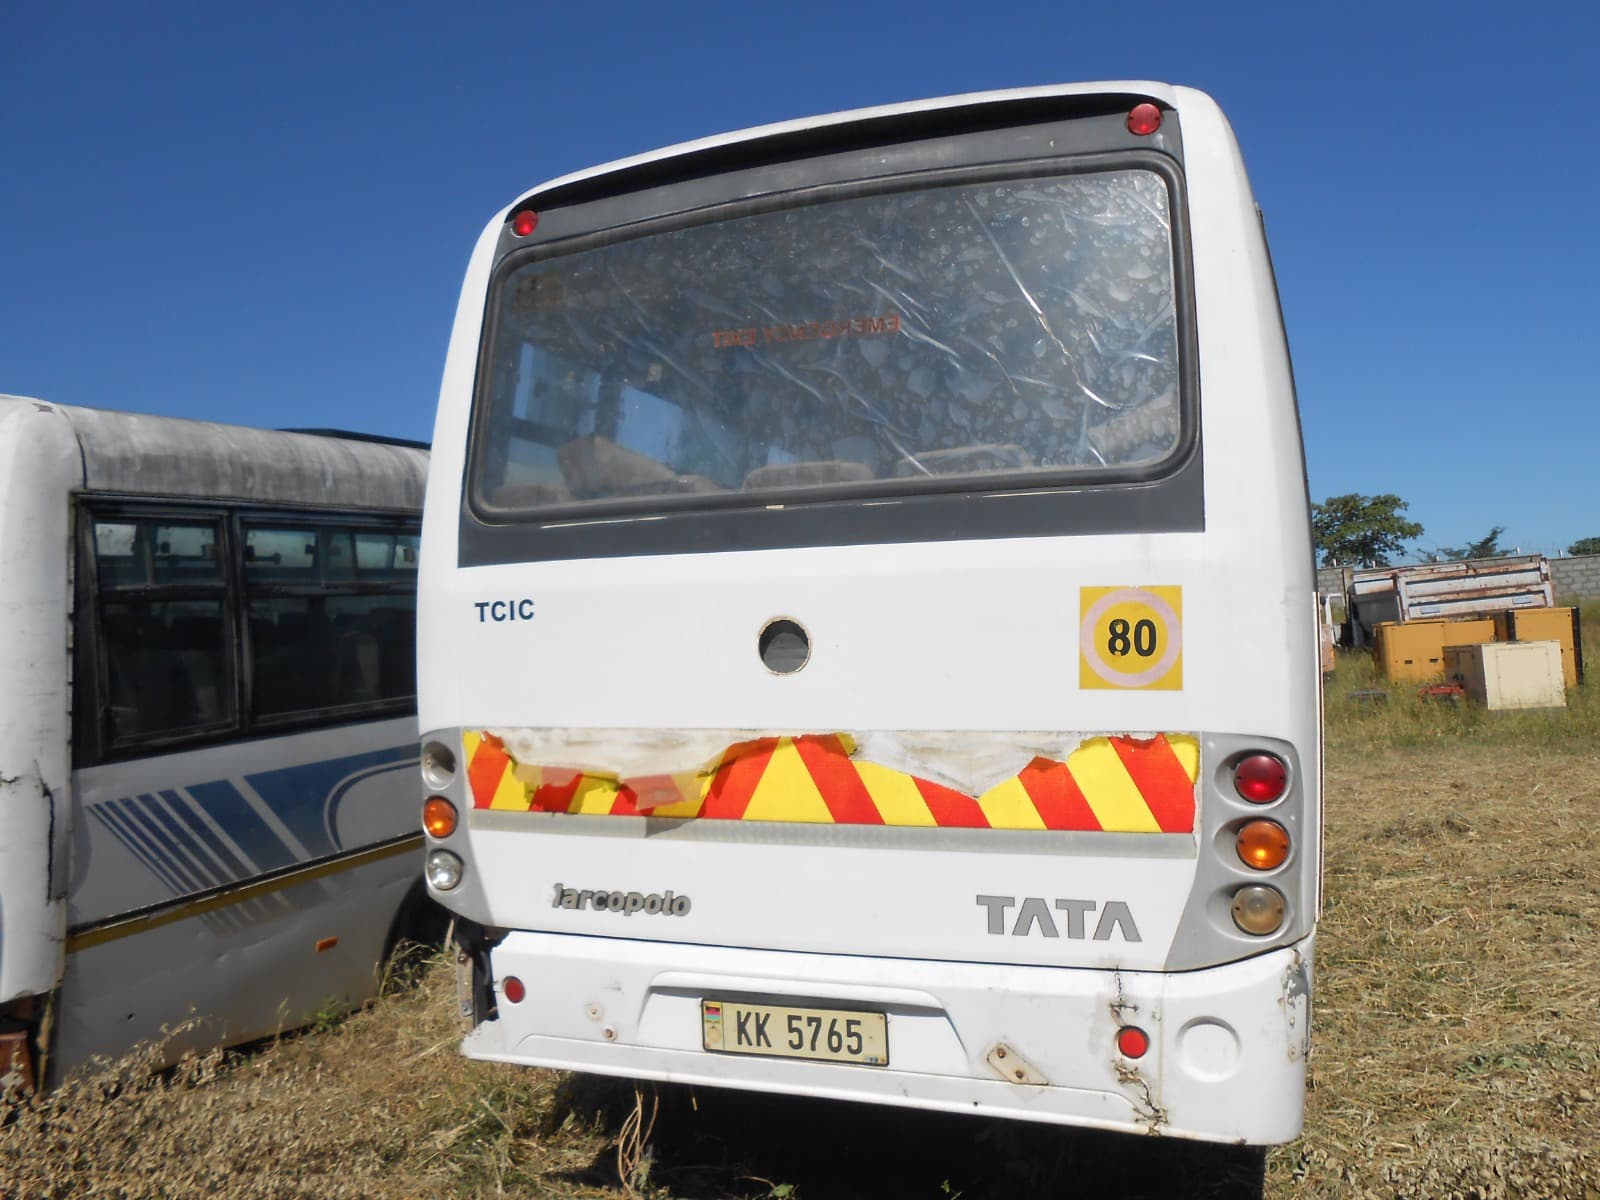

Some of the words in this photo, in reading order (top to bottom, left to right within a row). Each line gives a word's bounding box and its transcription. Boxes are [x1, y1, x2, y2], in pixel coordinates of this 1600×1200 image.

[474, 599, 535, 623] TCIC
[1107, 618, 1157, 657] 80
[976, 895, 1143, 943] TATA
[736, 1010, 772, 1048] KK
[787, 1014, 863, 1055] 5765
